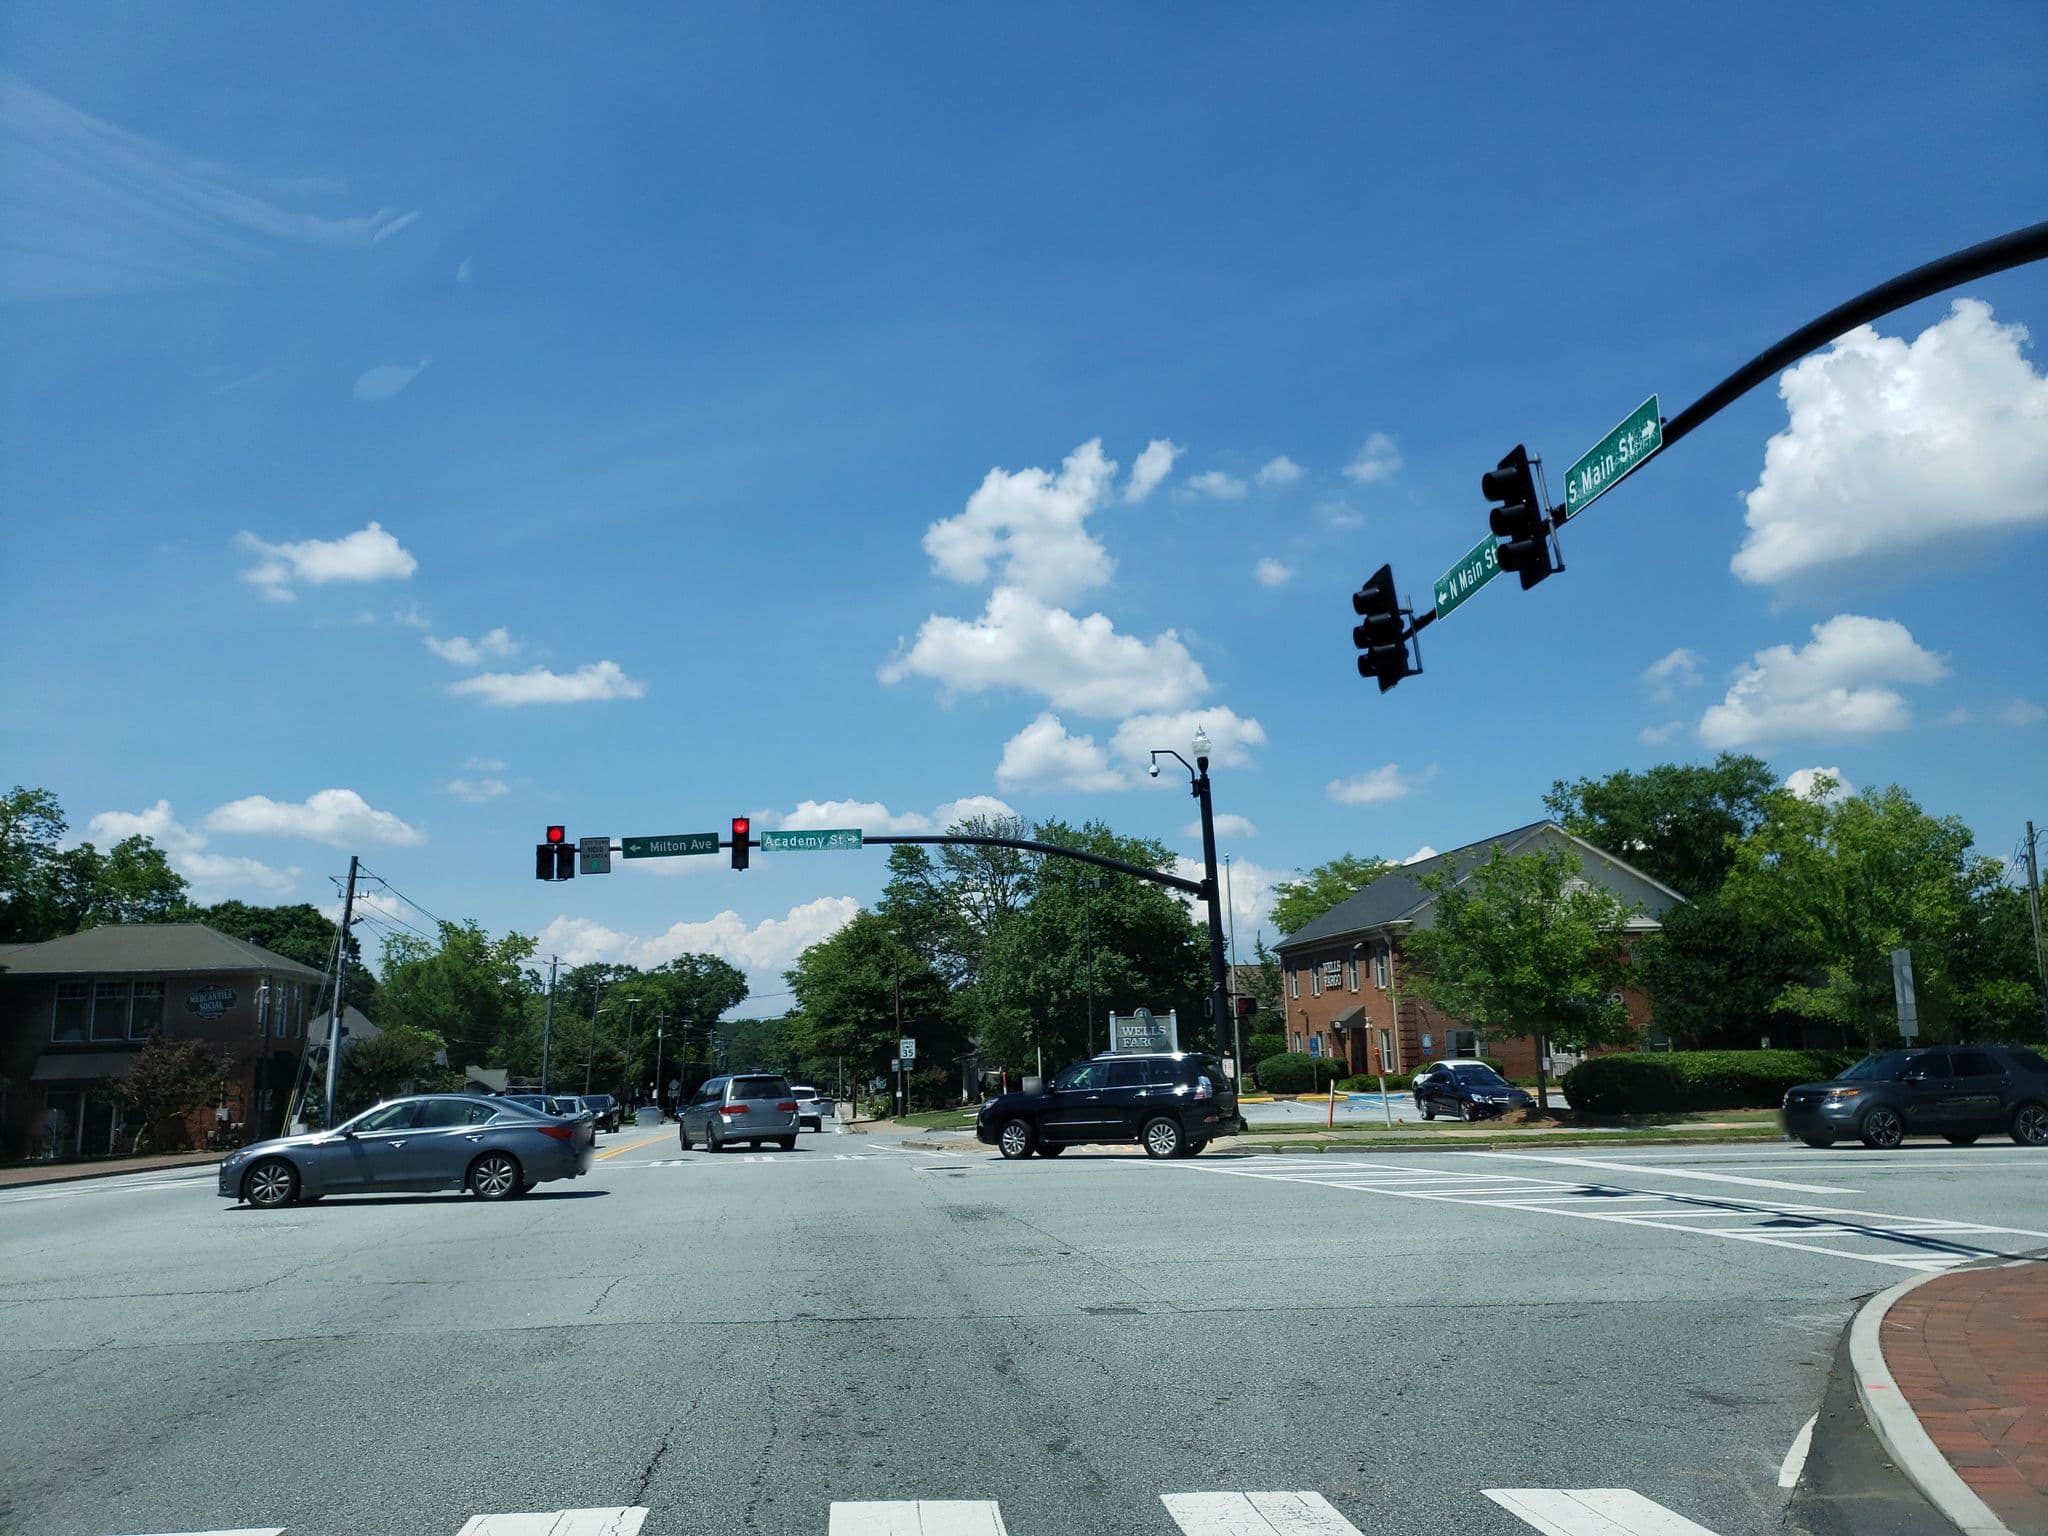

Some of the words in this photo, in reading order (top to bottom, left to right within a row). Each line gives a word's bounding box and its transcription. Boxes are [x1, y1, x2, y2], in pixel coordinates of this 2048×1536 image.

[1569, 480, 1577, 503] S
[1581, 454, 1614, 494] Main
[1619, 432, 1635, 463] St
[1449, 578, 1458, 599] N
[1458, 561, 1483, 592] Main
[1484, 545, 1498, 570] St
[650, 841, 687, 853] Milton
[690, 839, 712, 850] Ave
[764, 835, 825, 848] Academy
[830, 834, 844, 845] St
[1323, 960, 1341, 973] WELLS
[1324, 974, 1341, 987] FARGO
[1121, 1025, 1167, 1036] WELLS
[1123, 1037, 1156, 1048] FAR
